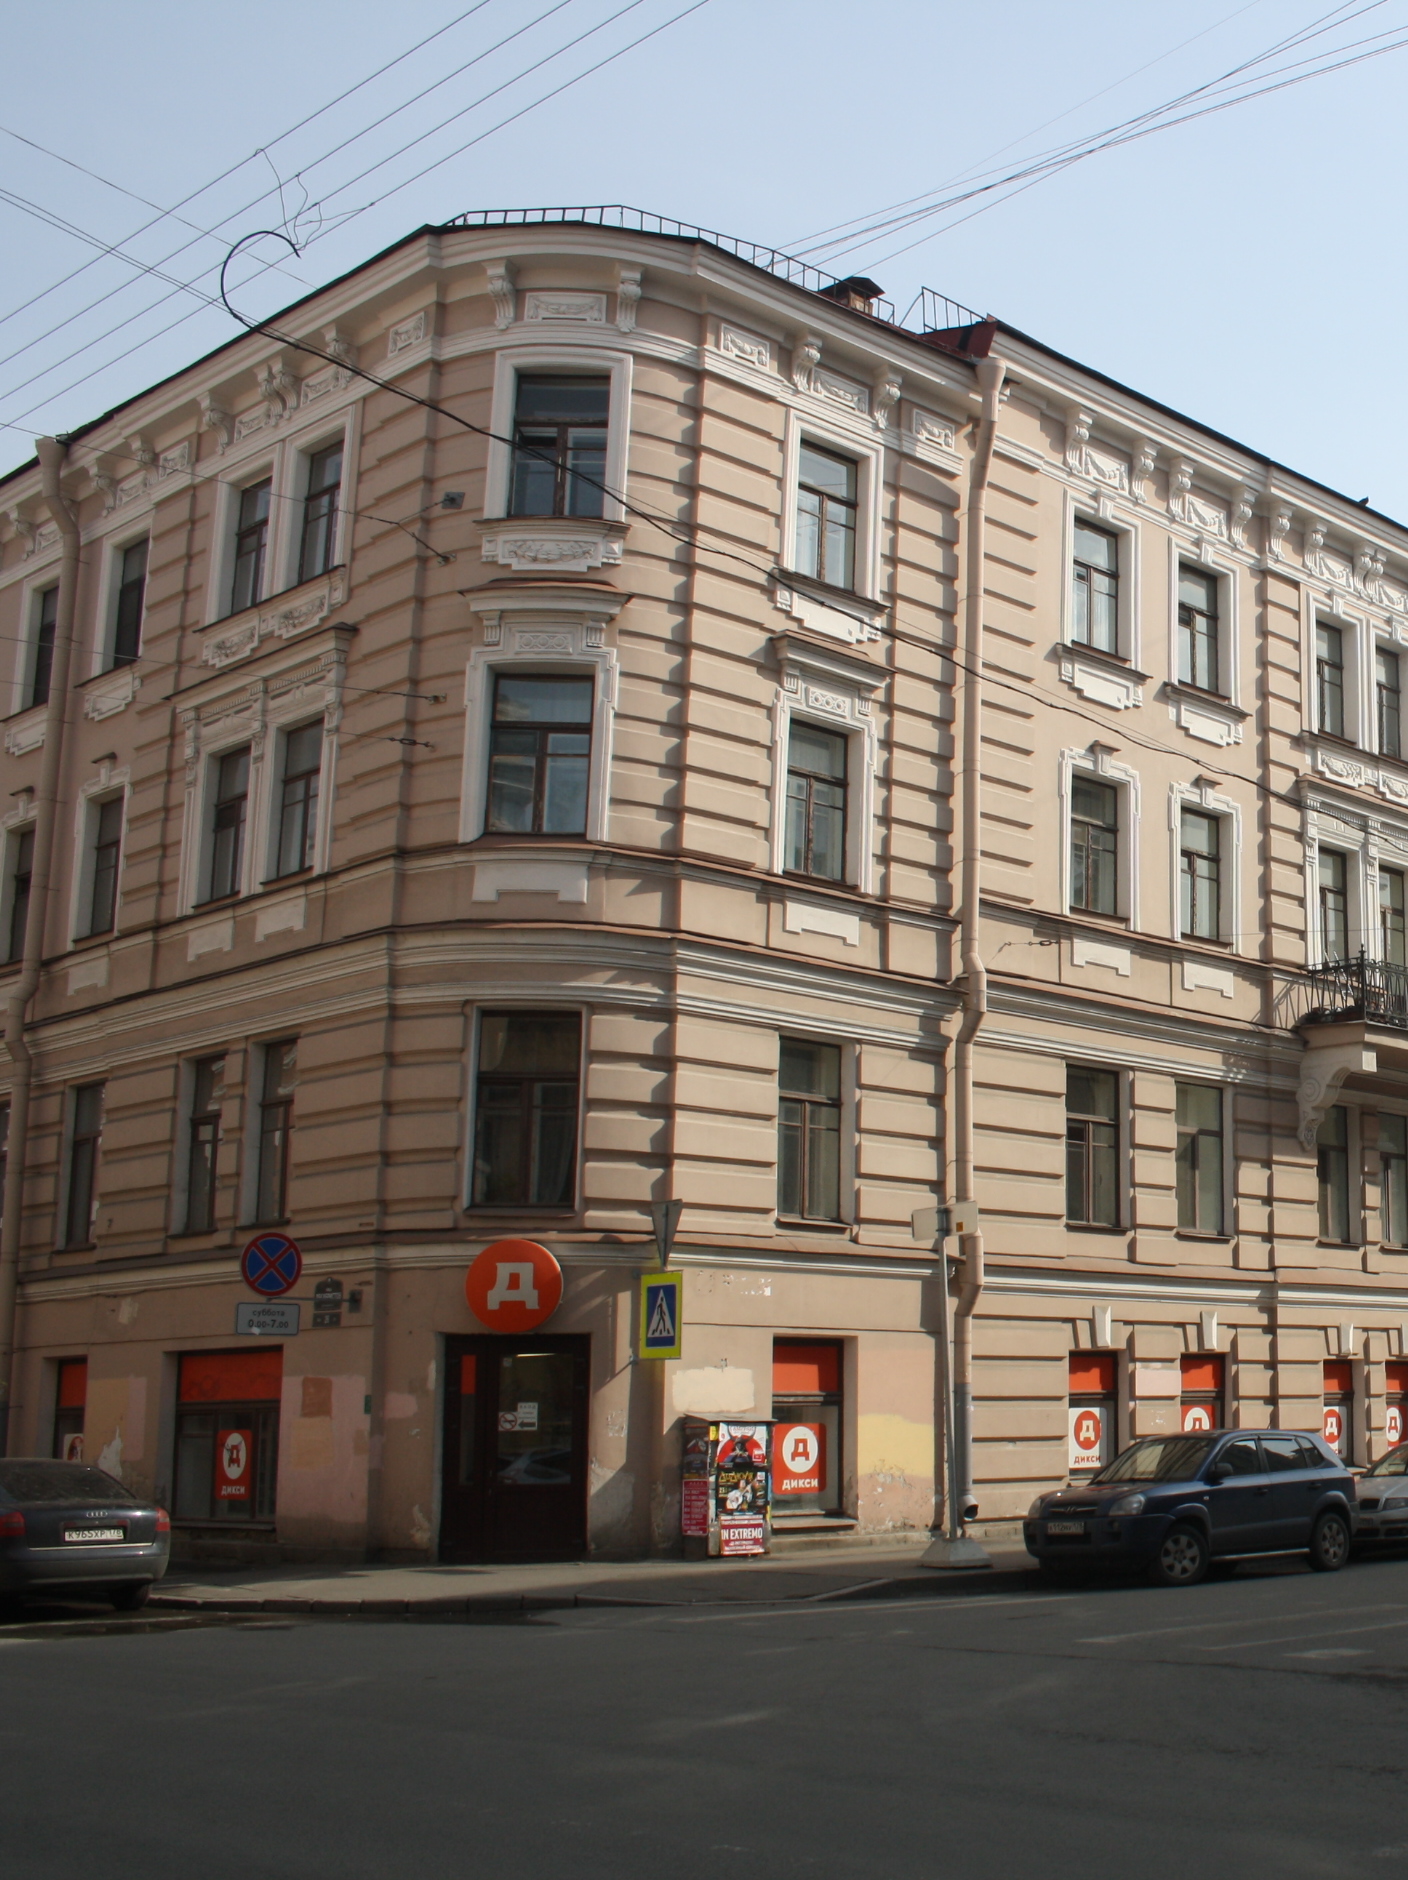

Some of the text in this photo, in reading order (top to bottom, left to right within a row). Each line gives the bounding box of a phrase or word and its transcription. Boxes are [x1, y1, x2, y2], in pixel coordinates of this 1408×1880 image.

[487, 1262, 539, 1310] Д
[252, 1308, 285, 1318] суббота
[248, 1319, 289, 1328] 0.00-7.00
[1080, 1420, 1096, 1441] Д
[1325, 1417, 1338, 1436] Д
[1388, 1416, 1399, 1433] Д
[791, 1438, 810, 1462] Д
[1074, 1455, 1101, 1464] ДИКСИ
[221, 1486, 245, 1496] ДИКСИ
[782, 1478, 819, 1491] ДИКСИ
[721, 1528, 763, 1540] IN EXTREMO
